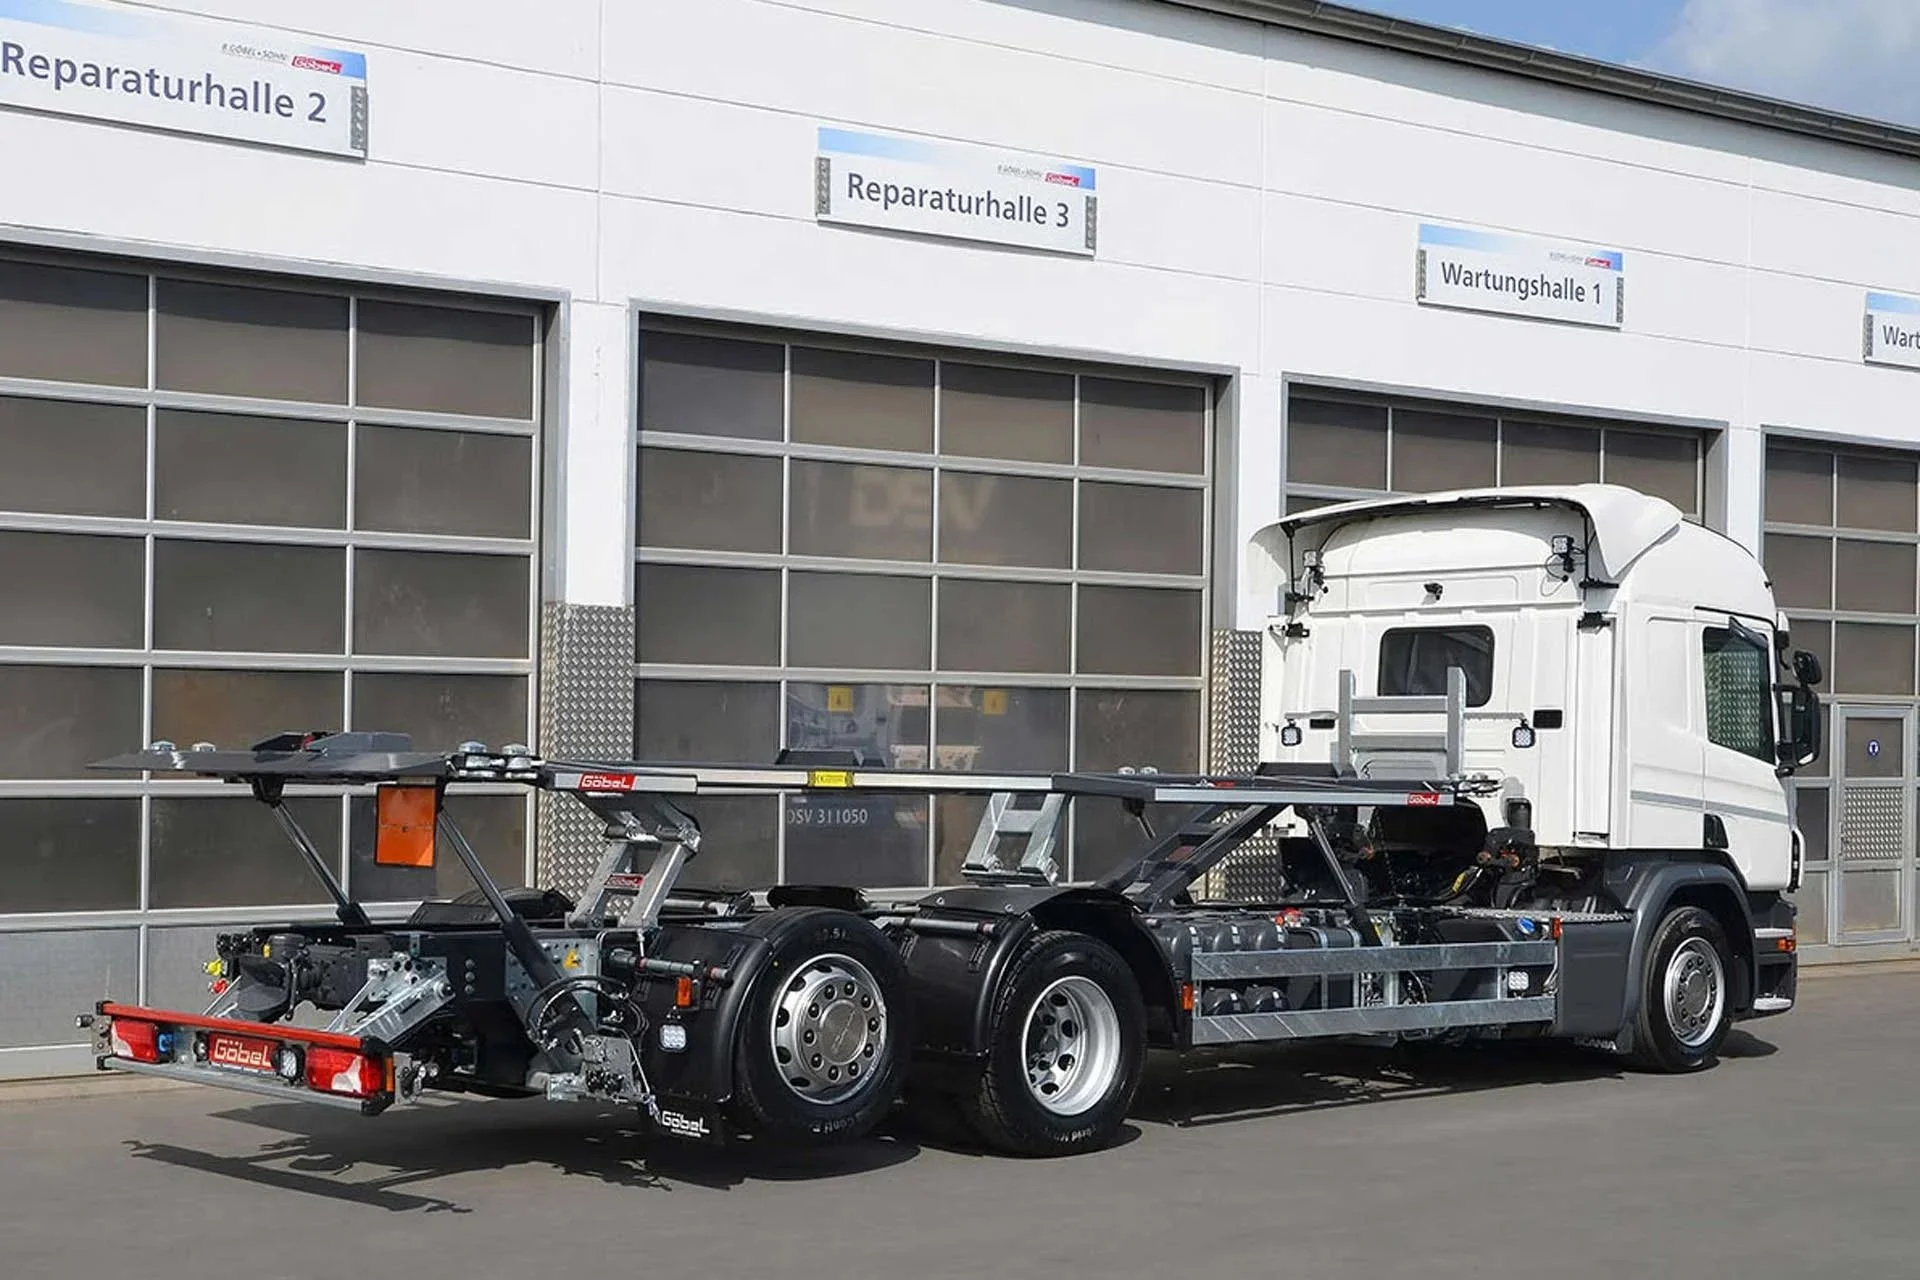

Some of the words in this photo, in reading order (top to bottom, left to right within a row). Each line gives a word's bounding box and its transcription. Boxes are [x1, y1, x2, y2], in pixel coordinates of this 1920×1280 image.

[1, 41, 294, 117] Reparaturhalle
[308, 92, 327, 123] 2
[848, 172, 1047, 226] Reparaturhalle
[1056, 202, 1070, 227] 3
[1441, 261, 1586, 303] Wartungshalle
[1592, 283, 1601, 304] 1
[787, 808, 813, 824] DSV
[817, 808, 868, 824] 311050
